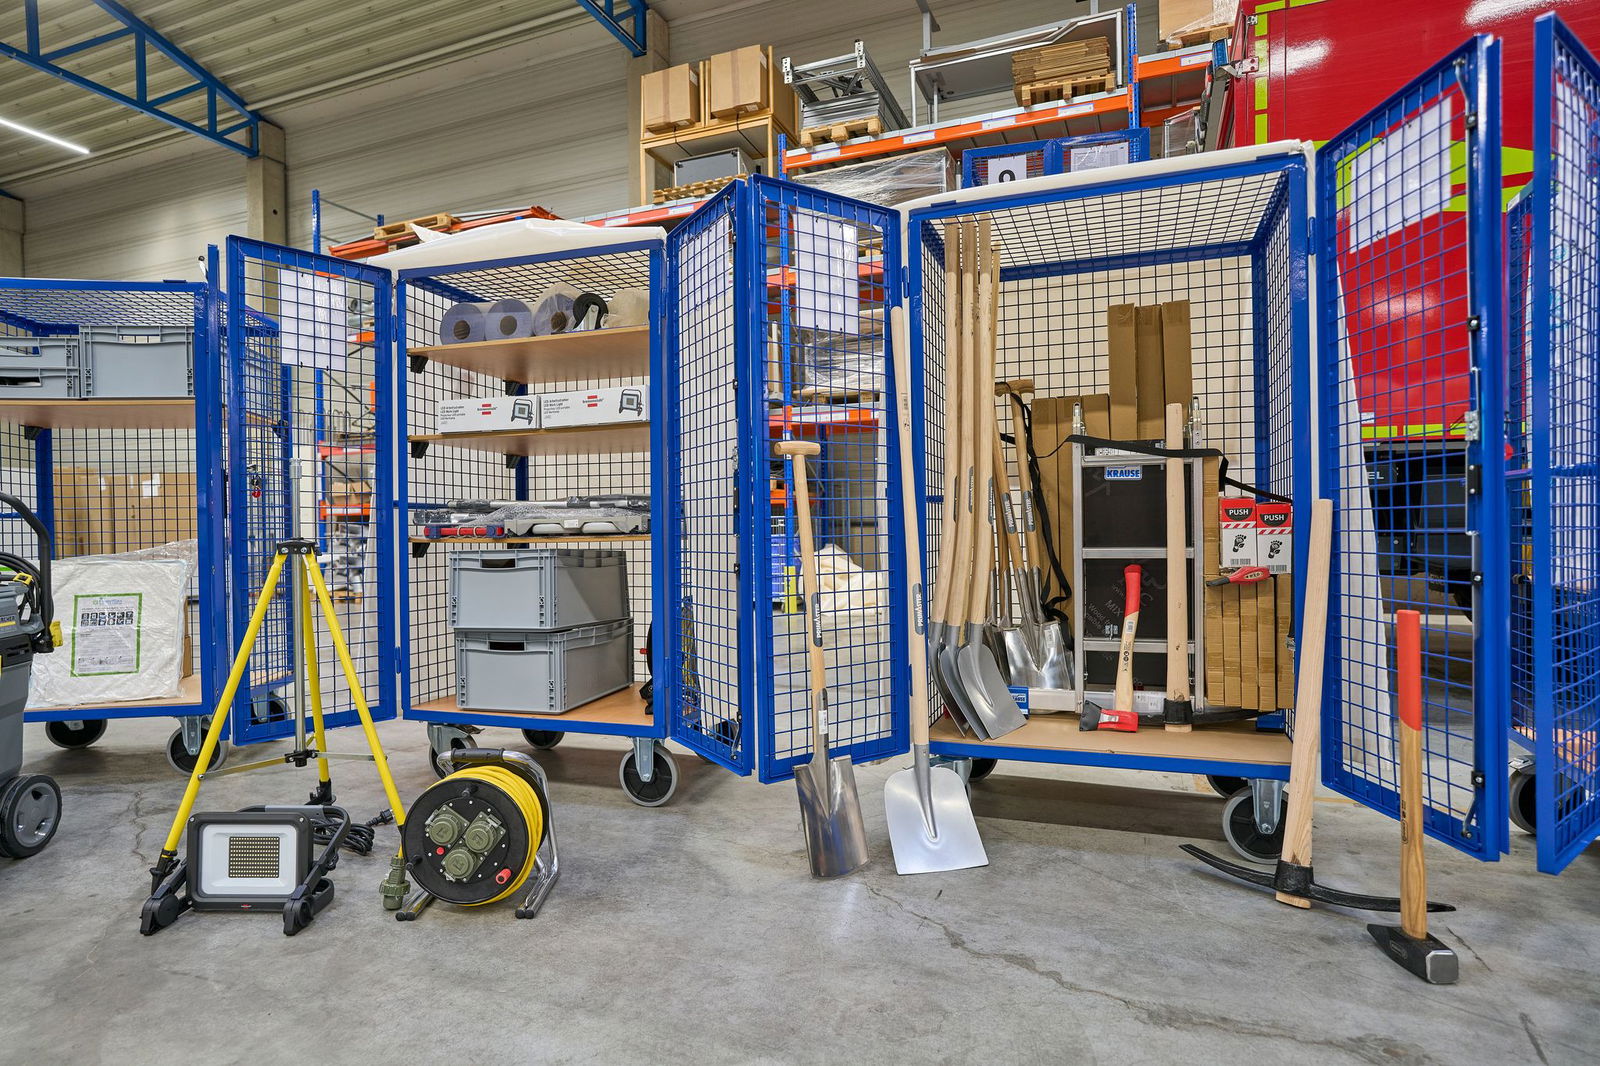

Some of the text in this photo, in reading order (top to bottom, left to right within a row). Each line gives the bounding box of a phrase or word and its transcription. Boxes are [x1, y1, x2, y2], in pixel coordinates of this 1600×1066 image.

[1107, 469, 1140, 478] KRAUSE
[813, 603, 822, 639] PRIMASTER
[915, 593, 924, 627] PRIMASTER
